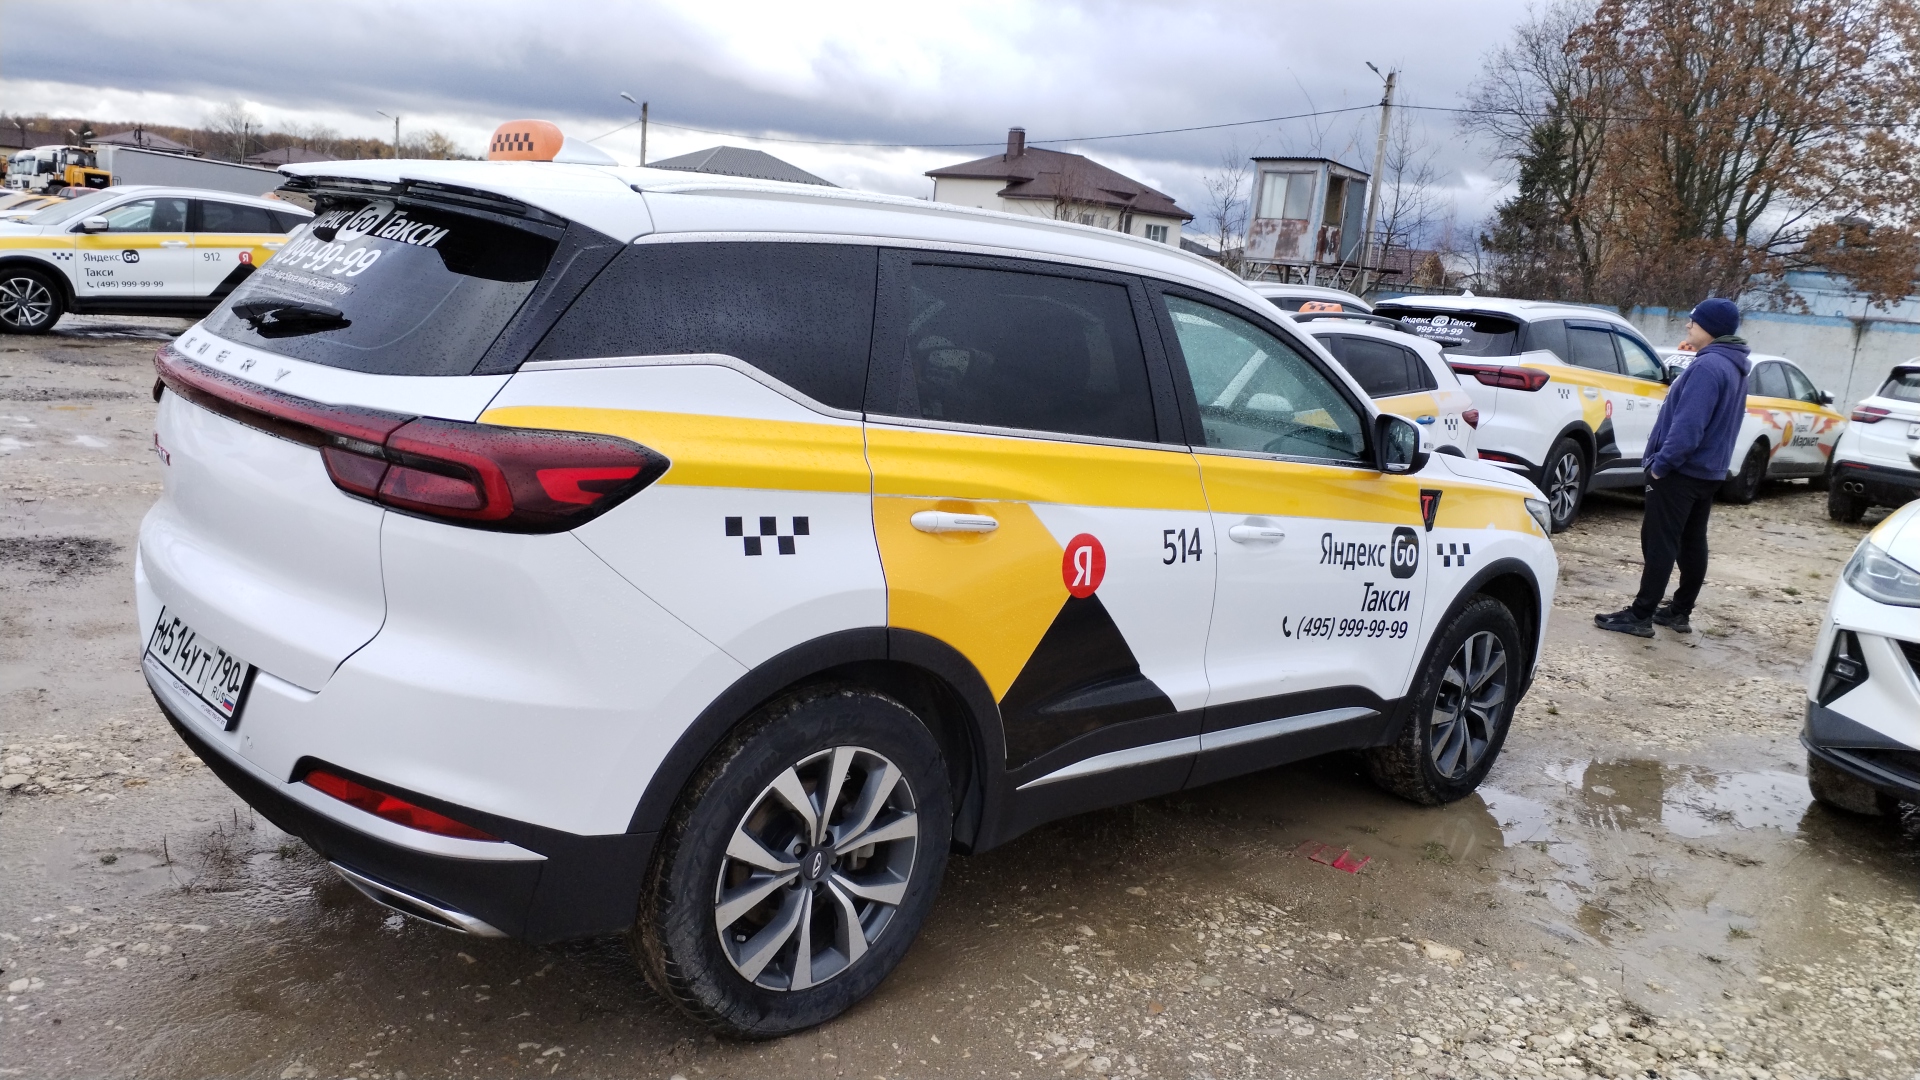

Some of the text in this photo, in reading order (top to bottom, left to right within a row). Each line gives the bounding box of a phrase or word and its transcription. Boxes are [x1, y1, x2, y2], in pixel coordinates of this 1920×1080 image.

[374, 210, 450, 247] Такси
[83, 251, 138, 262] Яндекс Go
[203, 252, 221, 262] 912
[84, 268, 114, 277] Такси
[121, 280, 164, 288] 999-99-99
[309, 278, 334, 290] Google
[332, 282, 351, 295] Play
[1401, 315, 1431, 324] Яндекс
[1449, 318, 1476, 328] Такси
[1416, 325, 1463, 335] 999-99-99
[184, 336, 291, 382] CHERY
[1790, 435, 1819, 448] Маркет
[1163, 527, 1202, 565] 514
[1319, 532, 1417, 570] Яндекс Go
[1072, 545, 1092, 587] Я
[1361, 582, 1410, 612] Такси
[1297, 616, 1408, 640] (495) 999-99-99
[211, 648, 241, 693] 790
[211, 685, 225, 704] RUS
